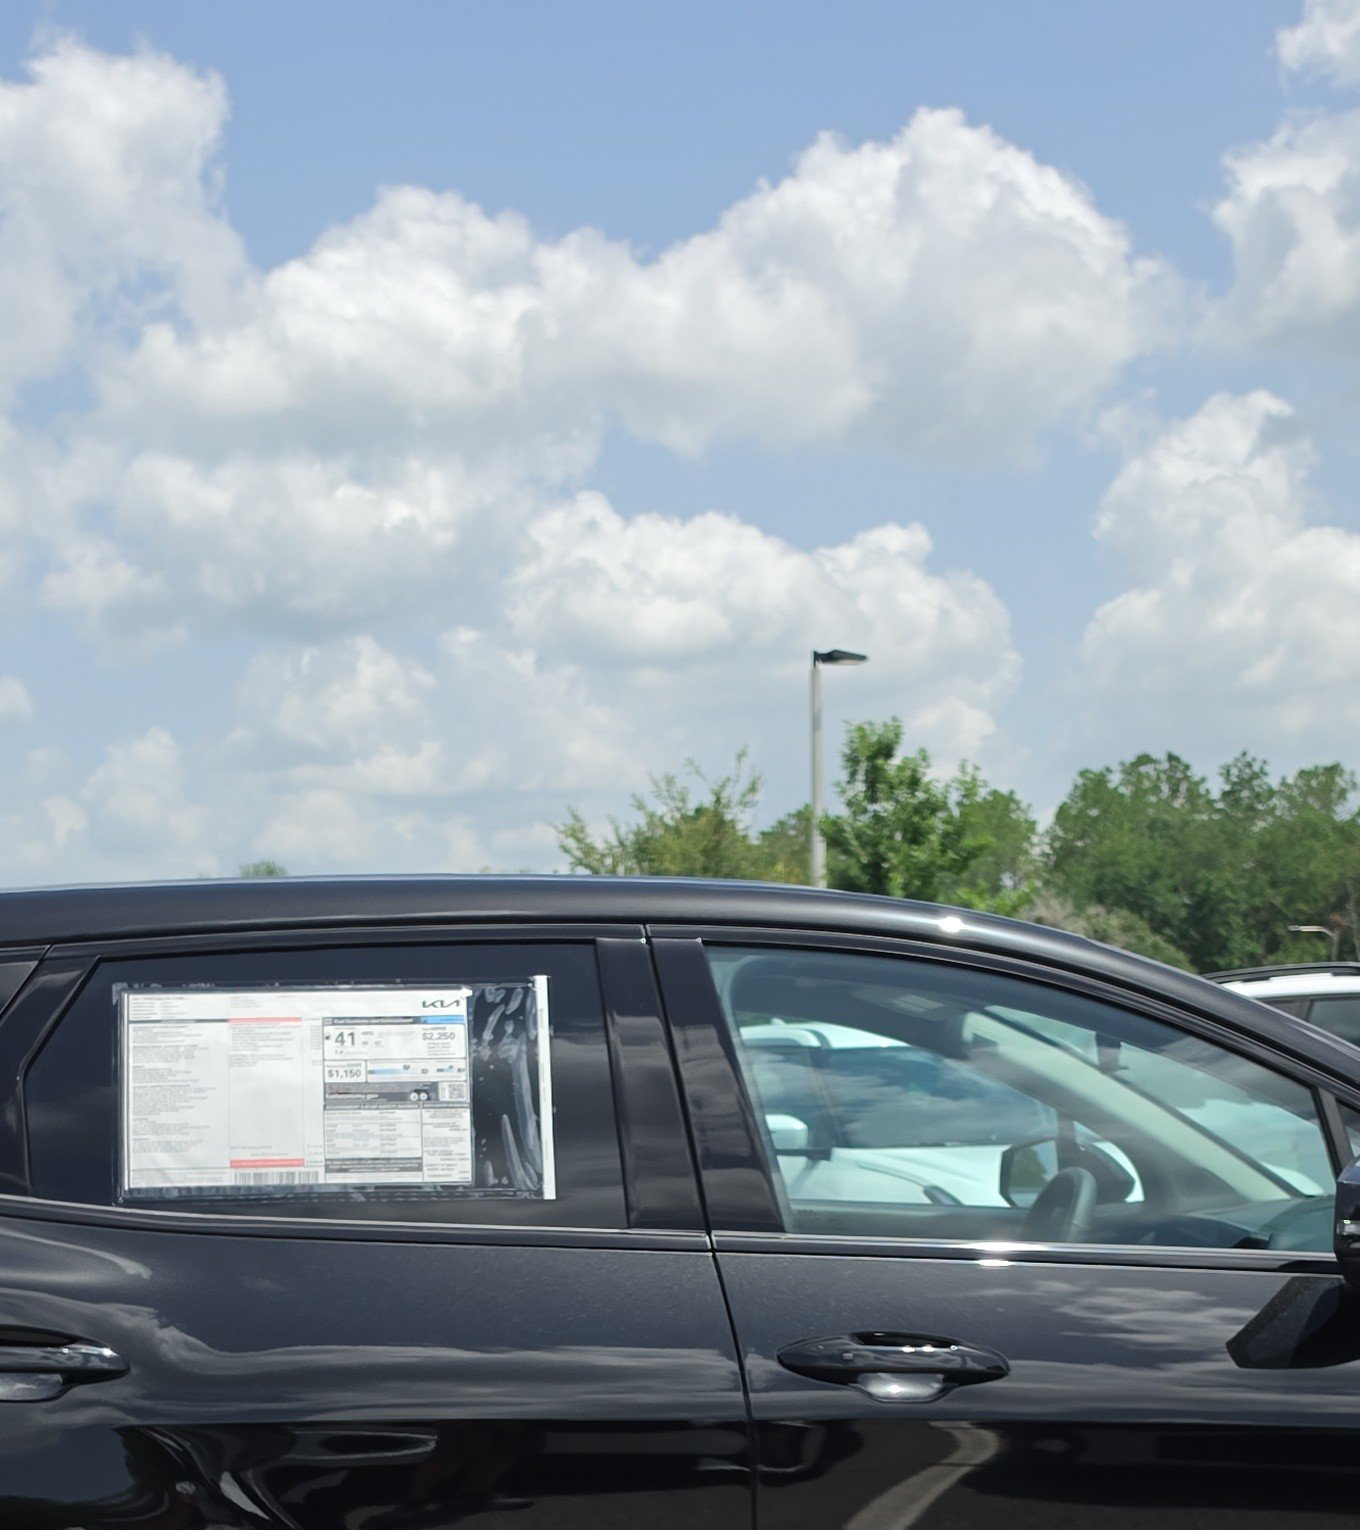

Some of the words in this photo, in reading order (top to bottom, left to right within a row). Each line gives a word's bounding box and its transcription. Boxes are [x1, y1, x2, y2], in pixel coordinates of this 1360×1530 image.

[422, 999, 461, 1009] KIA
[334, 1031, 355, 1046] 41
[328, 1069, 362, 1079] $1,150
